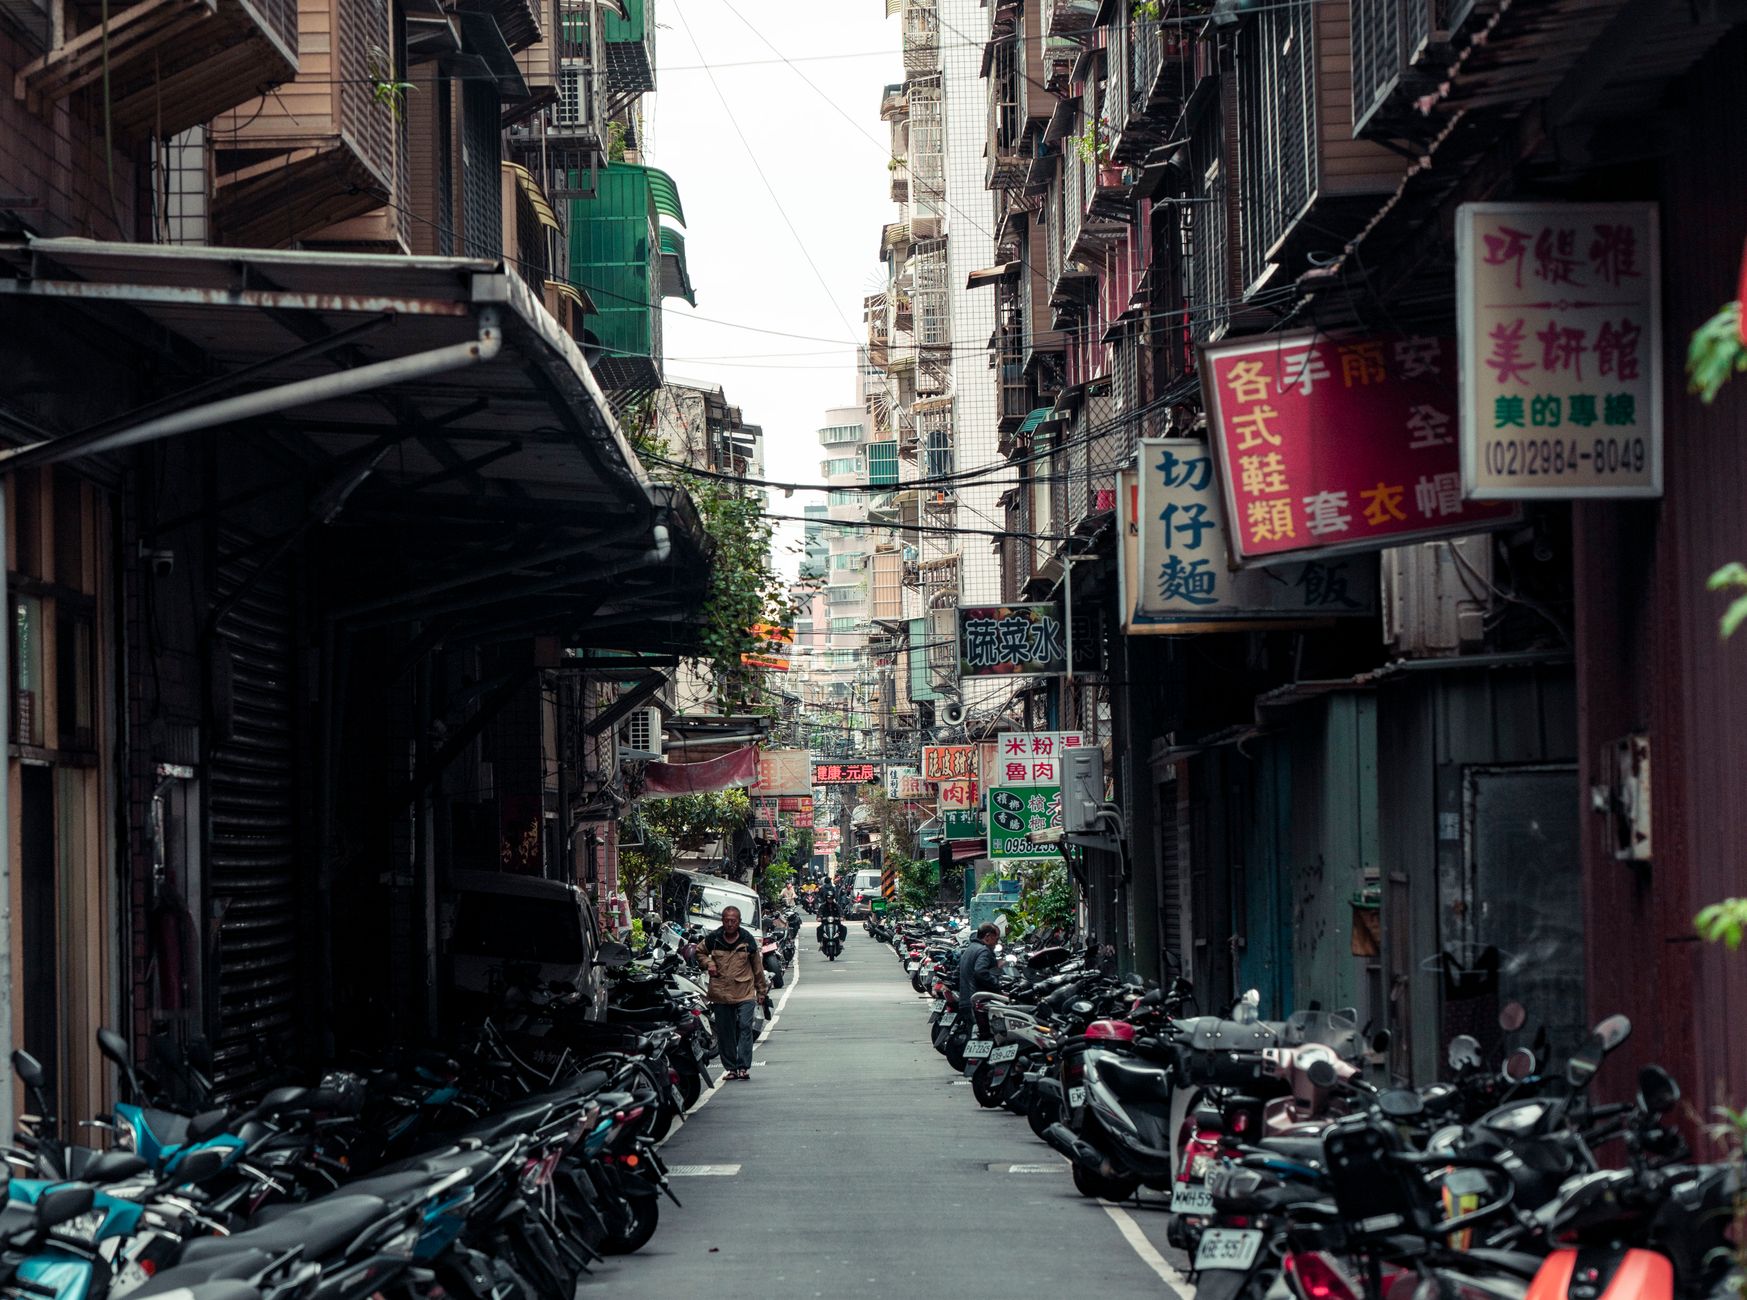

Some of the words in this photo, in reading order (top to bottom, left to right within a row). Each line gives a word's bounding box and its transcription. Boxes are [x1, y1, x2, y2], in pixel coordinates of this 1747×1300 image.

[1486, 318, 1643, 384] 美妍館
[1493, 393, 1637, 429] 美的專線
[1226, 360, 1296, 542] 各式鞋類
[1484, 437, 1646, 477] (02)2984-8049
[1156, 450, 1219, 605] 切仔麵
[1005, 762, 1053, 782] 魯肉
